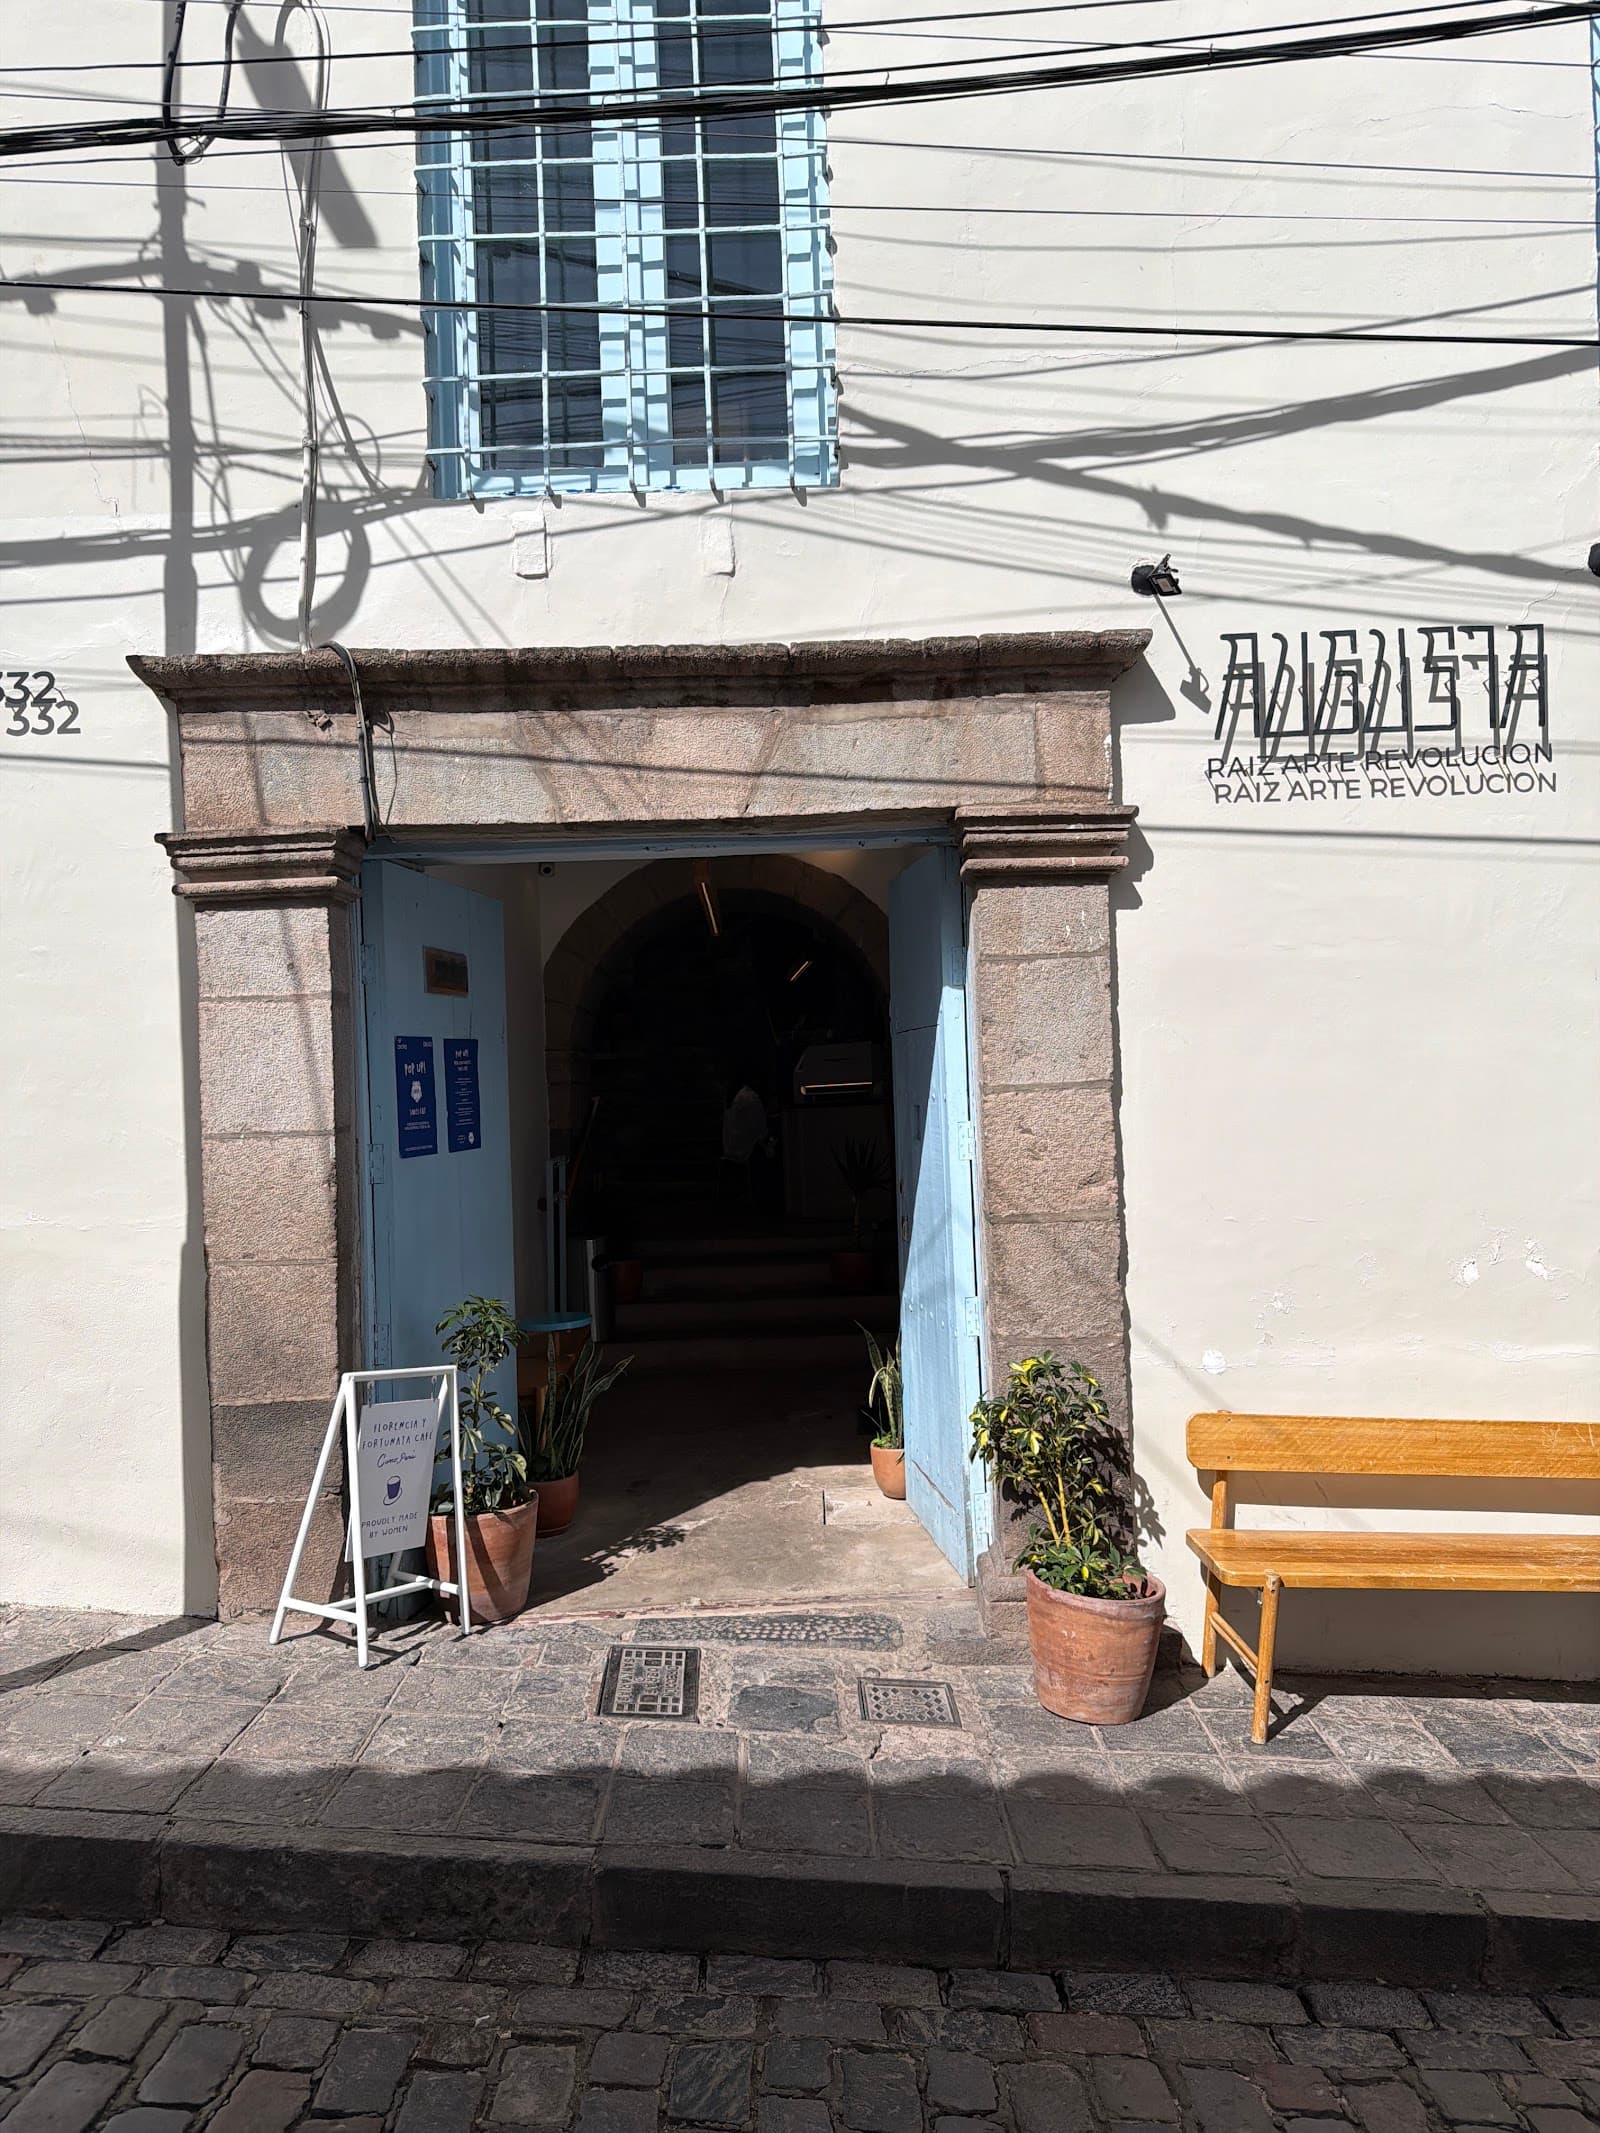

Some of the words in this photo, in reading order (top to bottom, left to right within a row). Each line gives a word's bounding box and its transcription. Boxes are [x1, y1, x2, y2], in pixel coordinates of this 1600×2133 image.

[0, 671, 57, 703] 32
[1214, 624, 1545, 741] AUGUSTA
[1207, 755, 1275, 778] RAIZ
[1281, 750, 1356, 775] ARTE
[1365, 743, 1553, 771] REVOLUCION
[362, 1434, 411, 1449] FORTUNATA
[361, 1516, 395, 1529] PROUDLY
[399, 1511, 418, 1522] MADE
[382, 1525, 408, 1537] WOMEN
